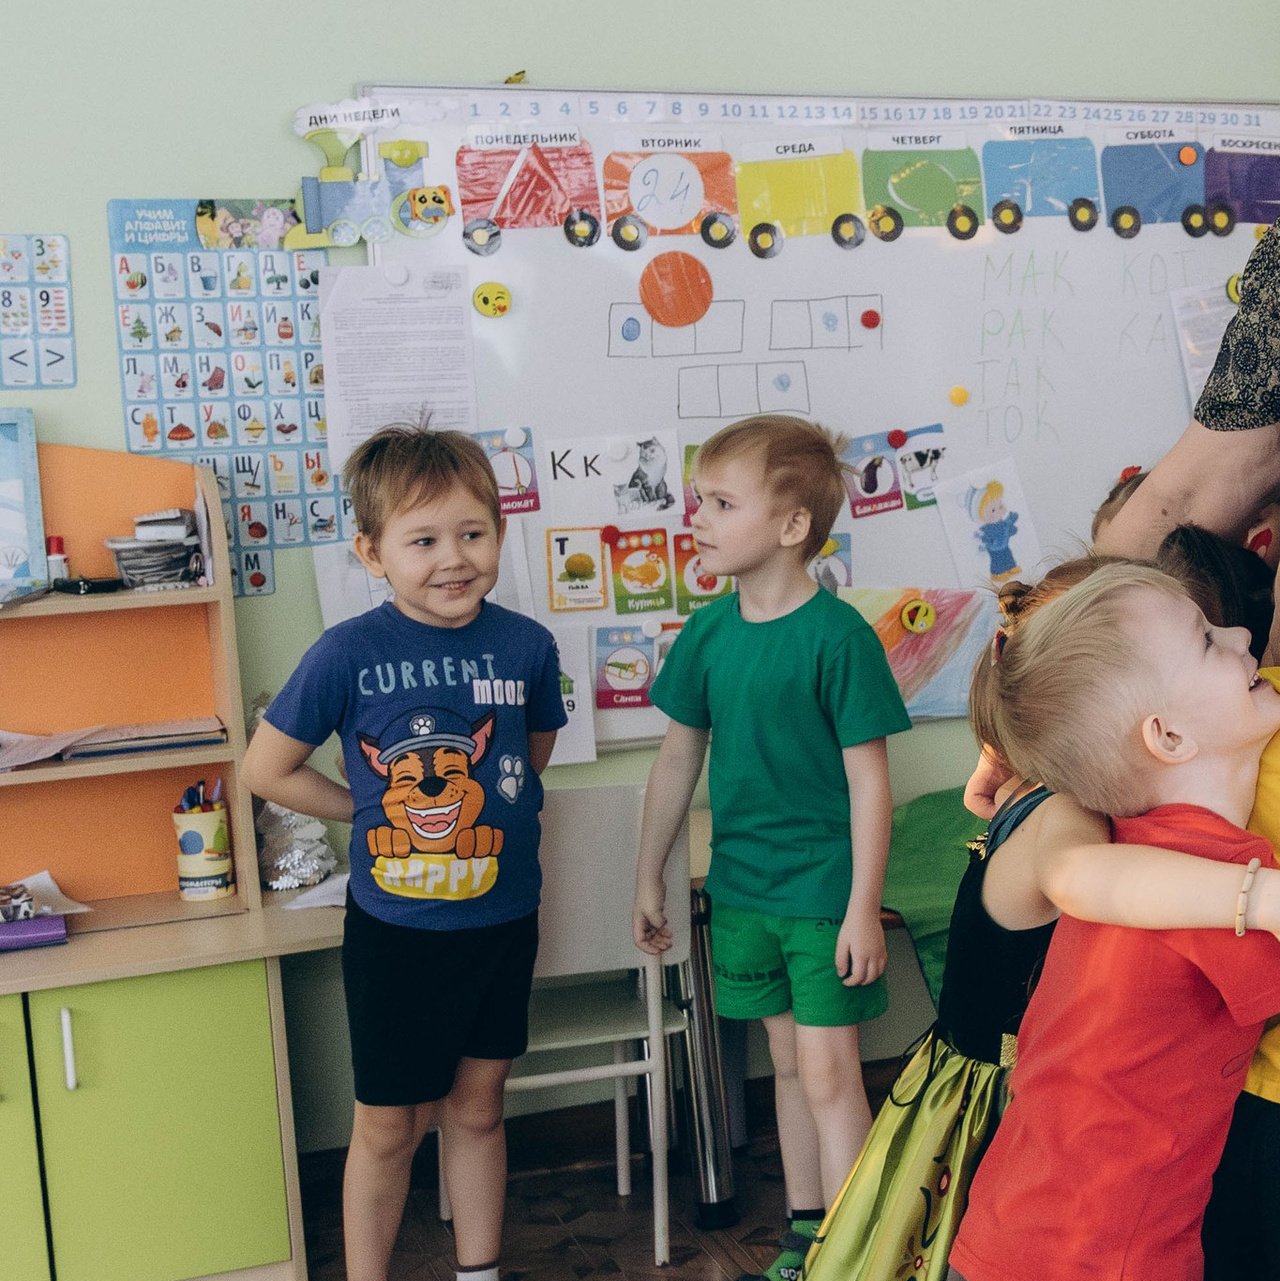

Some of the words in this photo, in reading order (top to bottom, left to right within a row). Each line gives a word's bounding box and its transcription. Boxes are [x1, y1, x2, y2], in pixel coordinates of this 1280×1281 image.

[308, 113, 338, 127] ДНИ
[343, 106, 400, 122] НЕДЕЛИ
[470, 103, 480, 117] 1
[500, 102, 511, 116] 2
[530, 102, 541, 116] 3
[560, 102, 571, 115] 4
[589, 101, 600, 115] 5
[617, 101, 628, 115] 6
[646, 101, 657, 115] 7
[671, 101, 682, 115] 8
[698, 102, 709, 116] 9
[721, 103, 742, 117] 10
[749, 105, 770, 118] 11
[777, 104, 798, 119] 12
[804, 105, 826, 119] 13
[832, 106, 853, 120] 14
[860, 107, 878, 120] 15
[884, 107, 903, 121] 16
[908, 107, 927, 120] 17
[933, 107, 952, 120] 18
[959, 106, 979, 119] 19
[984, 106, 1004, 119] 20
[1008, 105, 1026, 118] 21
[1033, 104, 1051, 118] 22
[1058, 106, 1077, 119] 23
[1083, 107, 1101, 120] 24
[1103, 109, 1122, 121] 25
[1127, 110, 1146, 121] 26
[1152, 110, 1170, 123] 27
[1175, 111, 1194, 124] 28
[1199, 112, 1216, 125] 29
[1221, 113, 1239, 126] 30
[1244, 114, 1261, 127] 31
[475, 132, 578, 146] ПОНЕДЕЛЬНИК
[892, 135, 942, 146] ЧЕТВЕРГ
[1009, 125, 1064, 136] ПЯТНИЦА
[1125, 129, 1175, 141] СУББОТА
[641, 138, 702, 148] ВТОРНИК
[775, 142, 815, 155] СРЕДА
[135, 209, 174, 221] УЧИМ
[125, 219, 188, 233] АЛФАВИТ
[35, 239, 45, 256] 3
[125, 232, 135, 243] И
[137, 232, 189, 245] ЦИФРЫ
[119, 256, 130, 275] А
[154, 256, 165, 274] Б
[190, 255, 201, 273] В
[227, 255, 235, 272] Г
[263, 255, 276, 274] Д
[297, 255, 306, 271] Е
[983, 250, 1075, 301] МАК
[1, 290, 12, 307] 8
[39, 290, 50, 307] 9
[121, 305, 131, 327] Ё
[158, 306, 176, 324] Ж
[195, 306, 205, 322] З
[230, 305, 243, 322] И
[265, 302, 277, 323] Й
[301, 303, 311, 320] К
[981, 308, 1064, 356] РАК
[126, 358, 137, 375] Л
[164, 356, 179, 373] М
[200, 356, 210, 372] Н
[234, 354, 245, 371] О
[269, 354, 280, 370] П
[304, 353, 314, 369] Р
[976, 356, 1056, 403] ТАК
[131, 408, 141, 425] С
[167, 407, 176, 423] Т
[203, 405, 213, 421] У
[237, 404, 251, 421] Ф
[274, 402, 284, 420] Х
[308, 401, 320, 421] Ц
[978, 400, 1061, 446] ТОК
[235, 456, 254, 476] Щ
[270, 454, 284, 472] Ъ
[305, 452, 321, 470] Ы
[551, 449, 575, 480] К
[240, 505, 252, 522] Я
[275, 502, 286, 520] Н
[310, 500, 319, 517] С
[555, 537, 569, 555] Т
[245, 553, 261, 570] М
[358, 653, 496, 696] CURRENT
[384, 857, 489, 893] HAPPY
